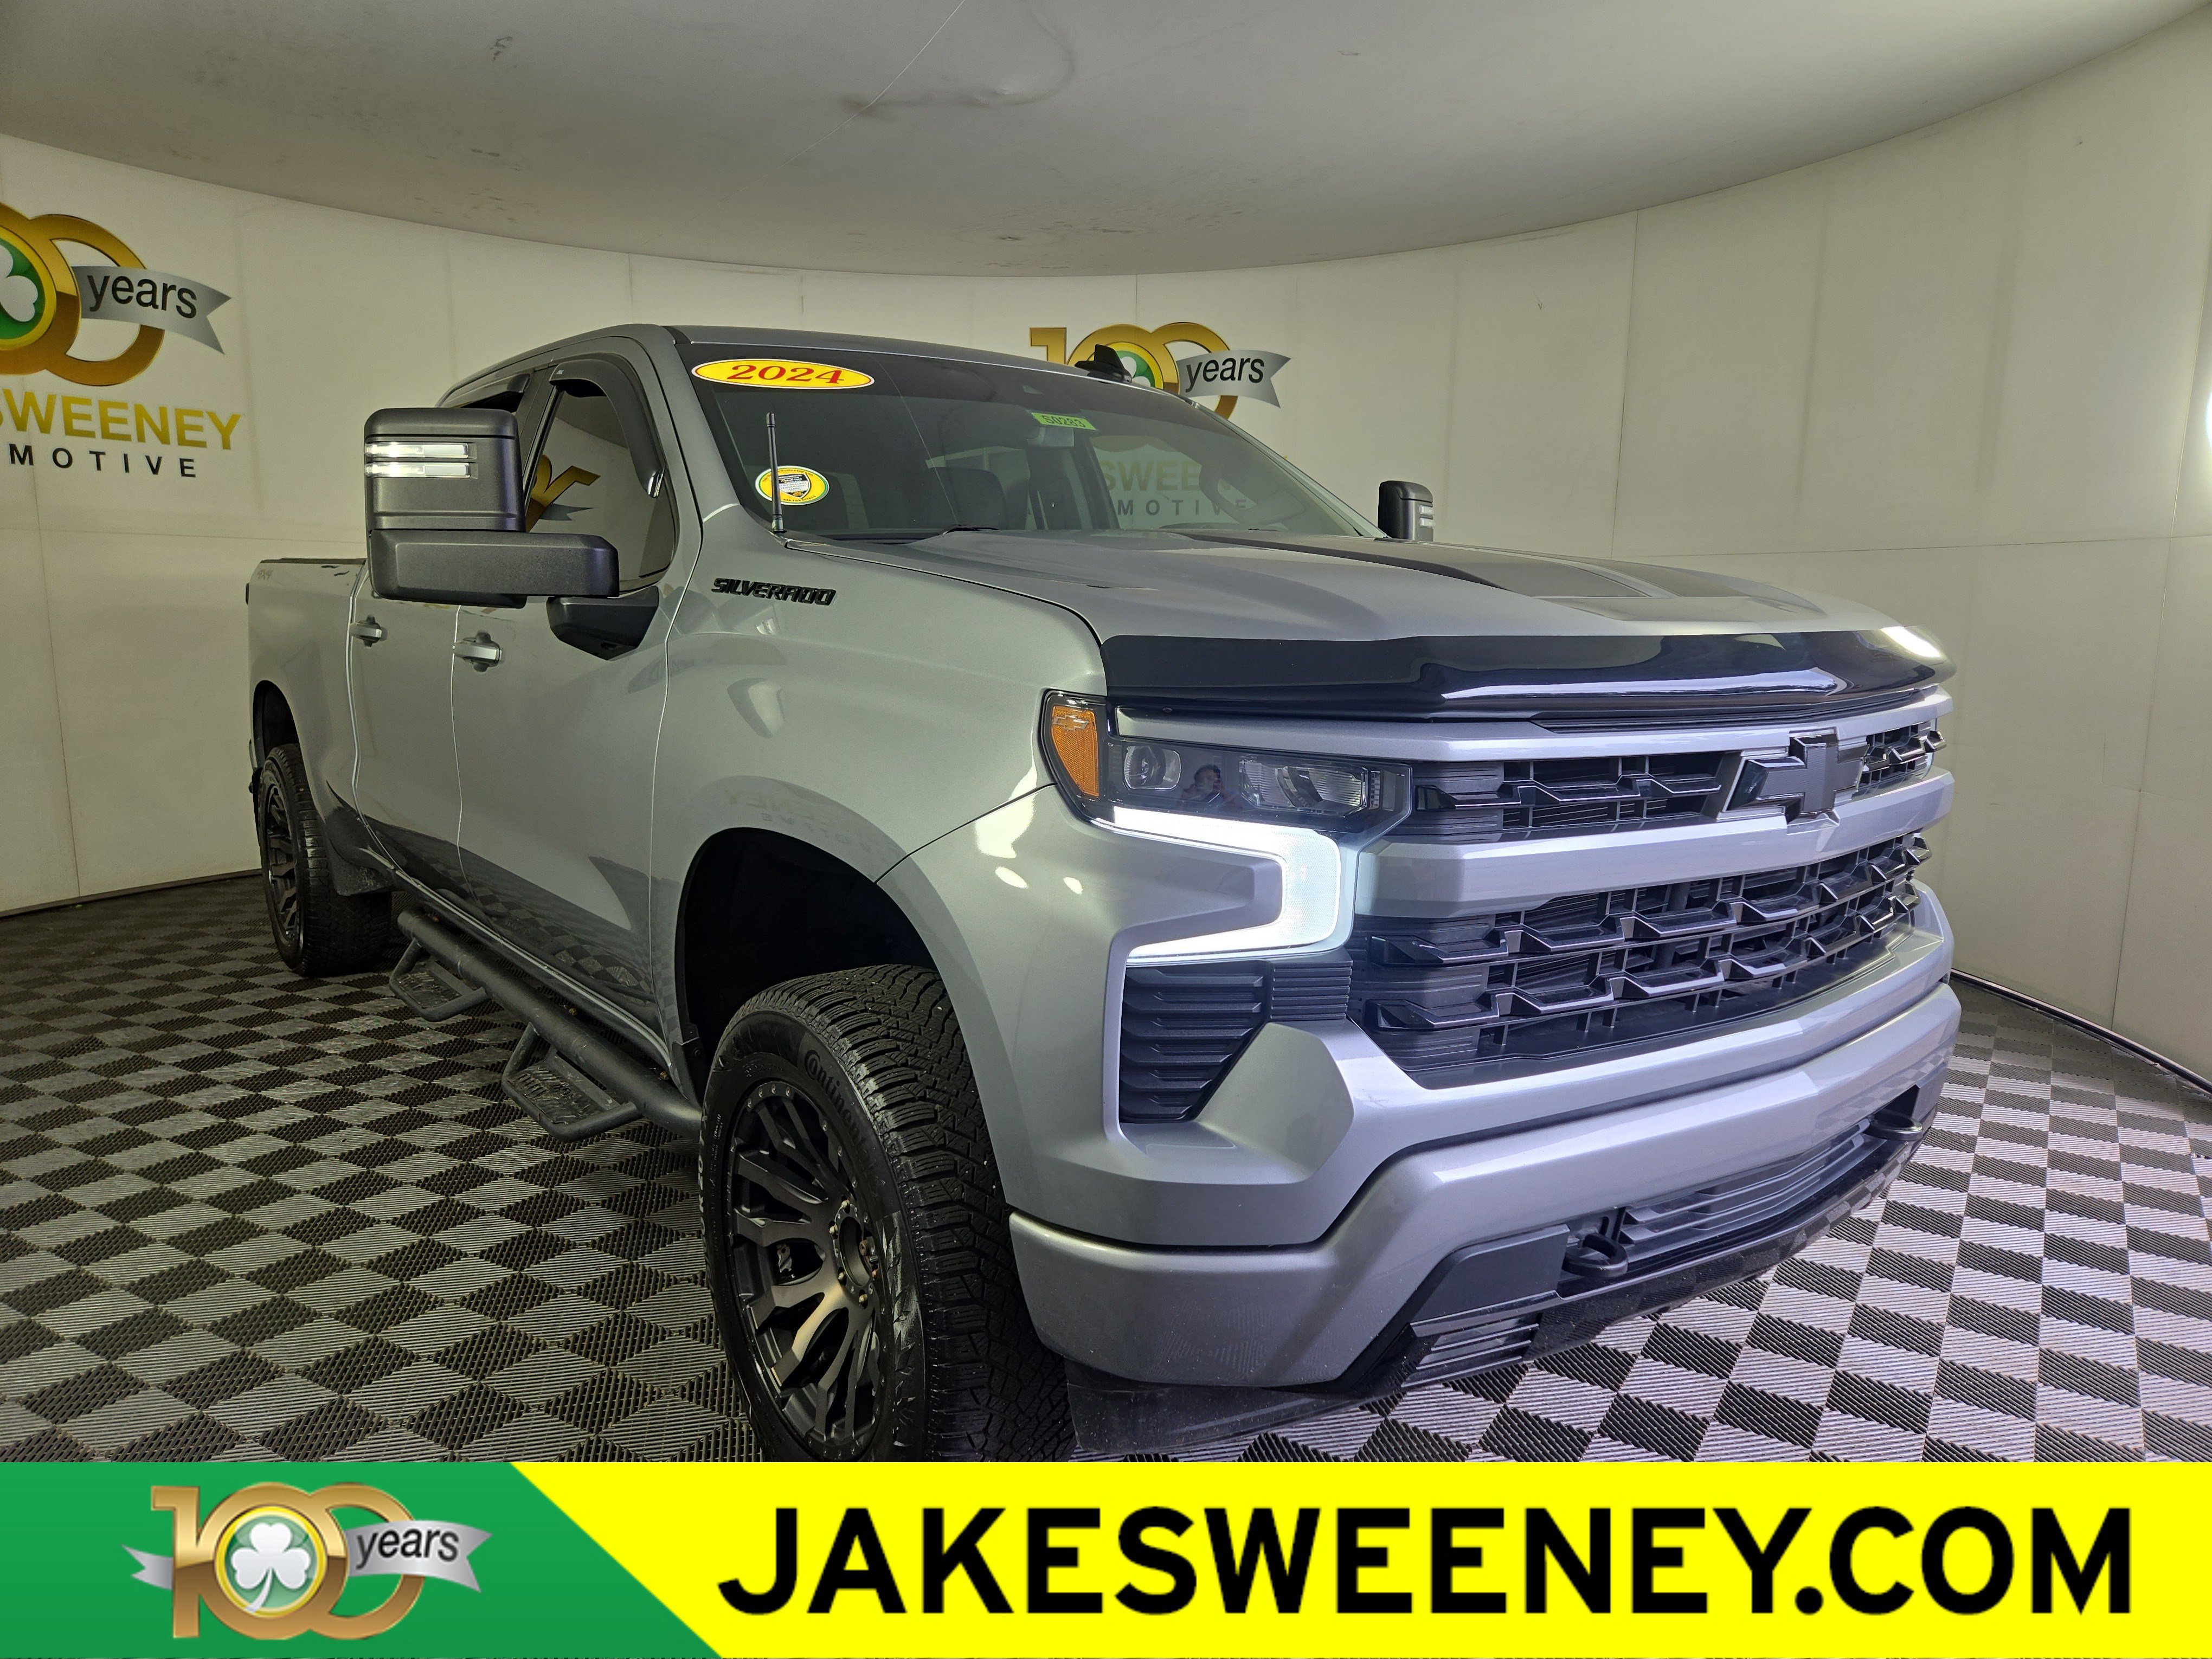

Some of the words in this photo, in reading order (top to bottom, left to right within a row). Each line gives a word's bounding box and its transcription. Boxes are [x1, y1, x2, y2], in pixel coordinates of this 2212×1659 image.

[87, 274, 197, 319] years
[726, 364, 845, 384] 2024
[1185, 357, 1265, 393] years
[711, 577, 837, 606] SILVERADO
